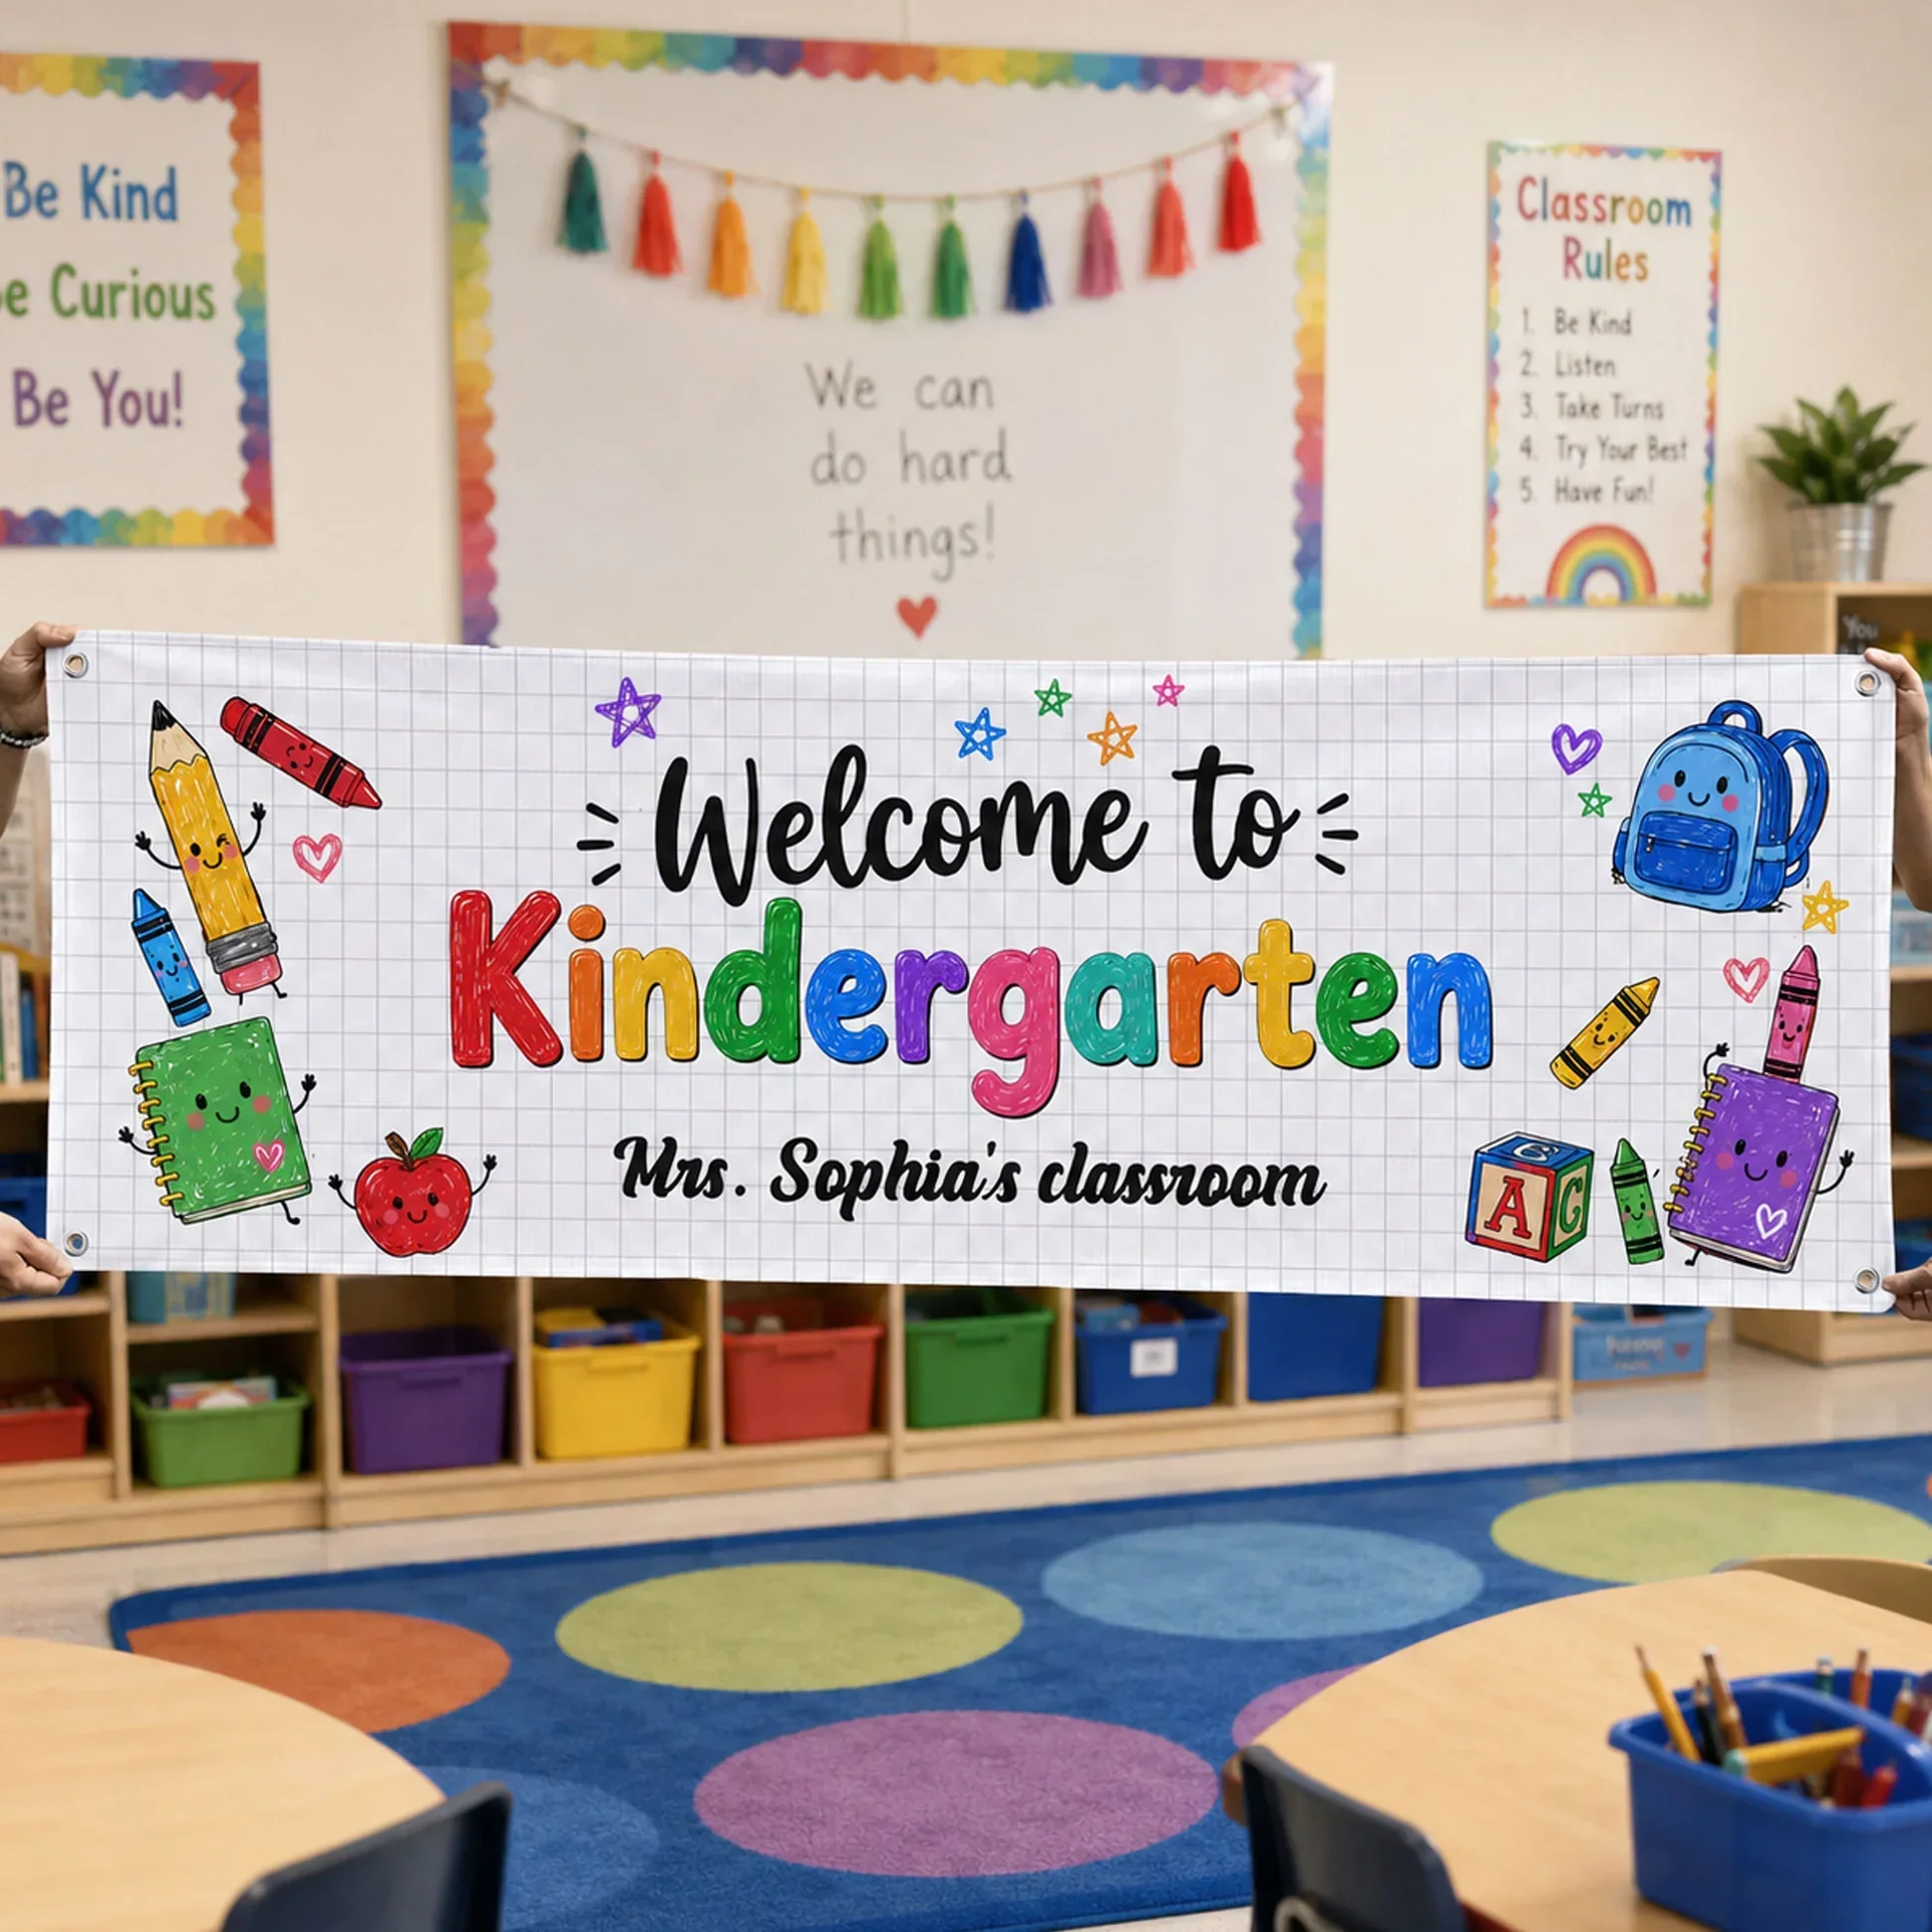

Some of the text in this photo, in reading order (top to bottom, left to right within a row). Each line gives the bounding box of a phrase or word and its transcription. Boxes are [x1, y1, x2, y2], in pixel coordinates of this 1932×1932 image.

[4, 161, 179, 222] Be Kind
[1517, 176, 1692, 227] Classroom
[1564, 236, 1649, 282] Rules
[0, 262, 215, 321] e Curious
[1522, 307, 1633, 336] 1. Be Kind
[802, 359, 995, 411] We can
[1520, 349, 1616, 377] 2. Listen
[13, 368, 184, 428] Be You!
[1520, 391, 1664, 421] 3. Take Turns
[809, 425, 1014, 485] do hard
[1519, 434, 1688, 470] 4. Try Your Best
[1555, 477, 1602, 503] Have
[1613, 475, 1654, 502] Fun!
[827, 499, 995, 584] things!
[1843, 615, 1878, 639] You
[655, 744, 1301, 907] Welcome to
[449, 890, 1493, 1119] Kindergarten
[614, 1136, 1327, 1222] Mrs. Sophia's classroom
[1484, 1175, 1532, 1239] A
[1560, 1176, 1583, 1233] C
